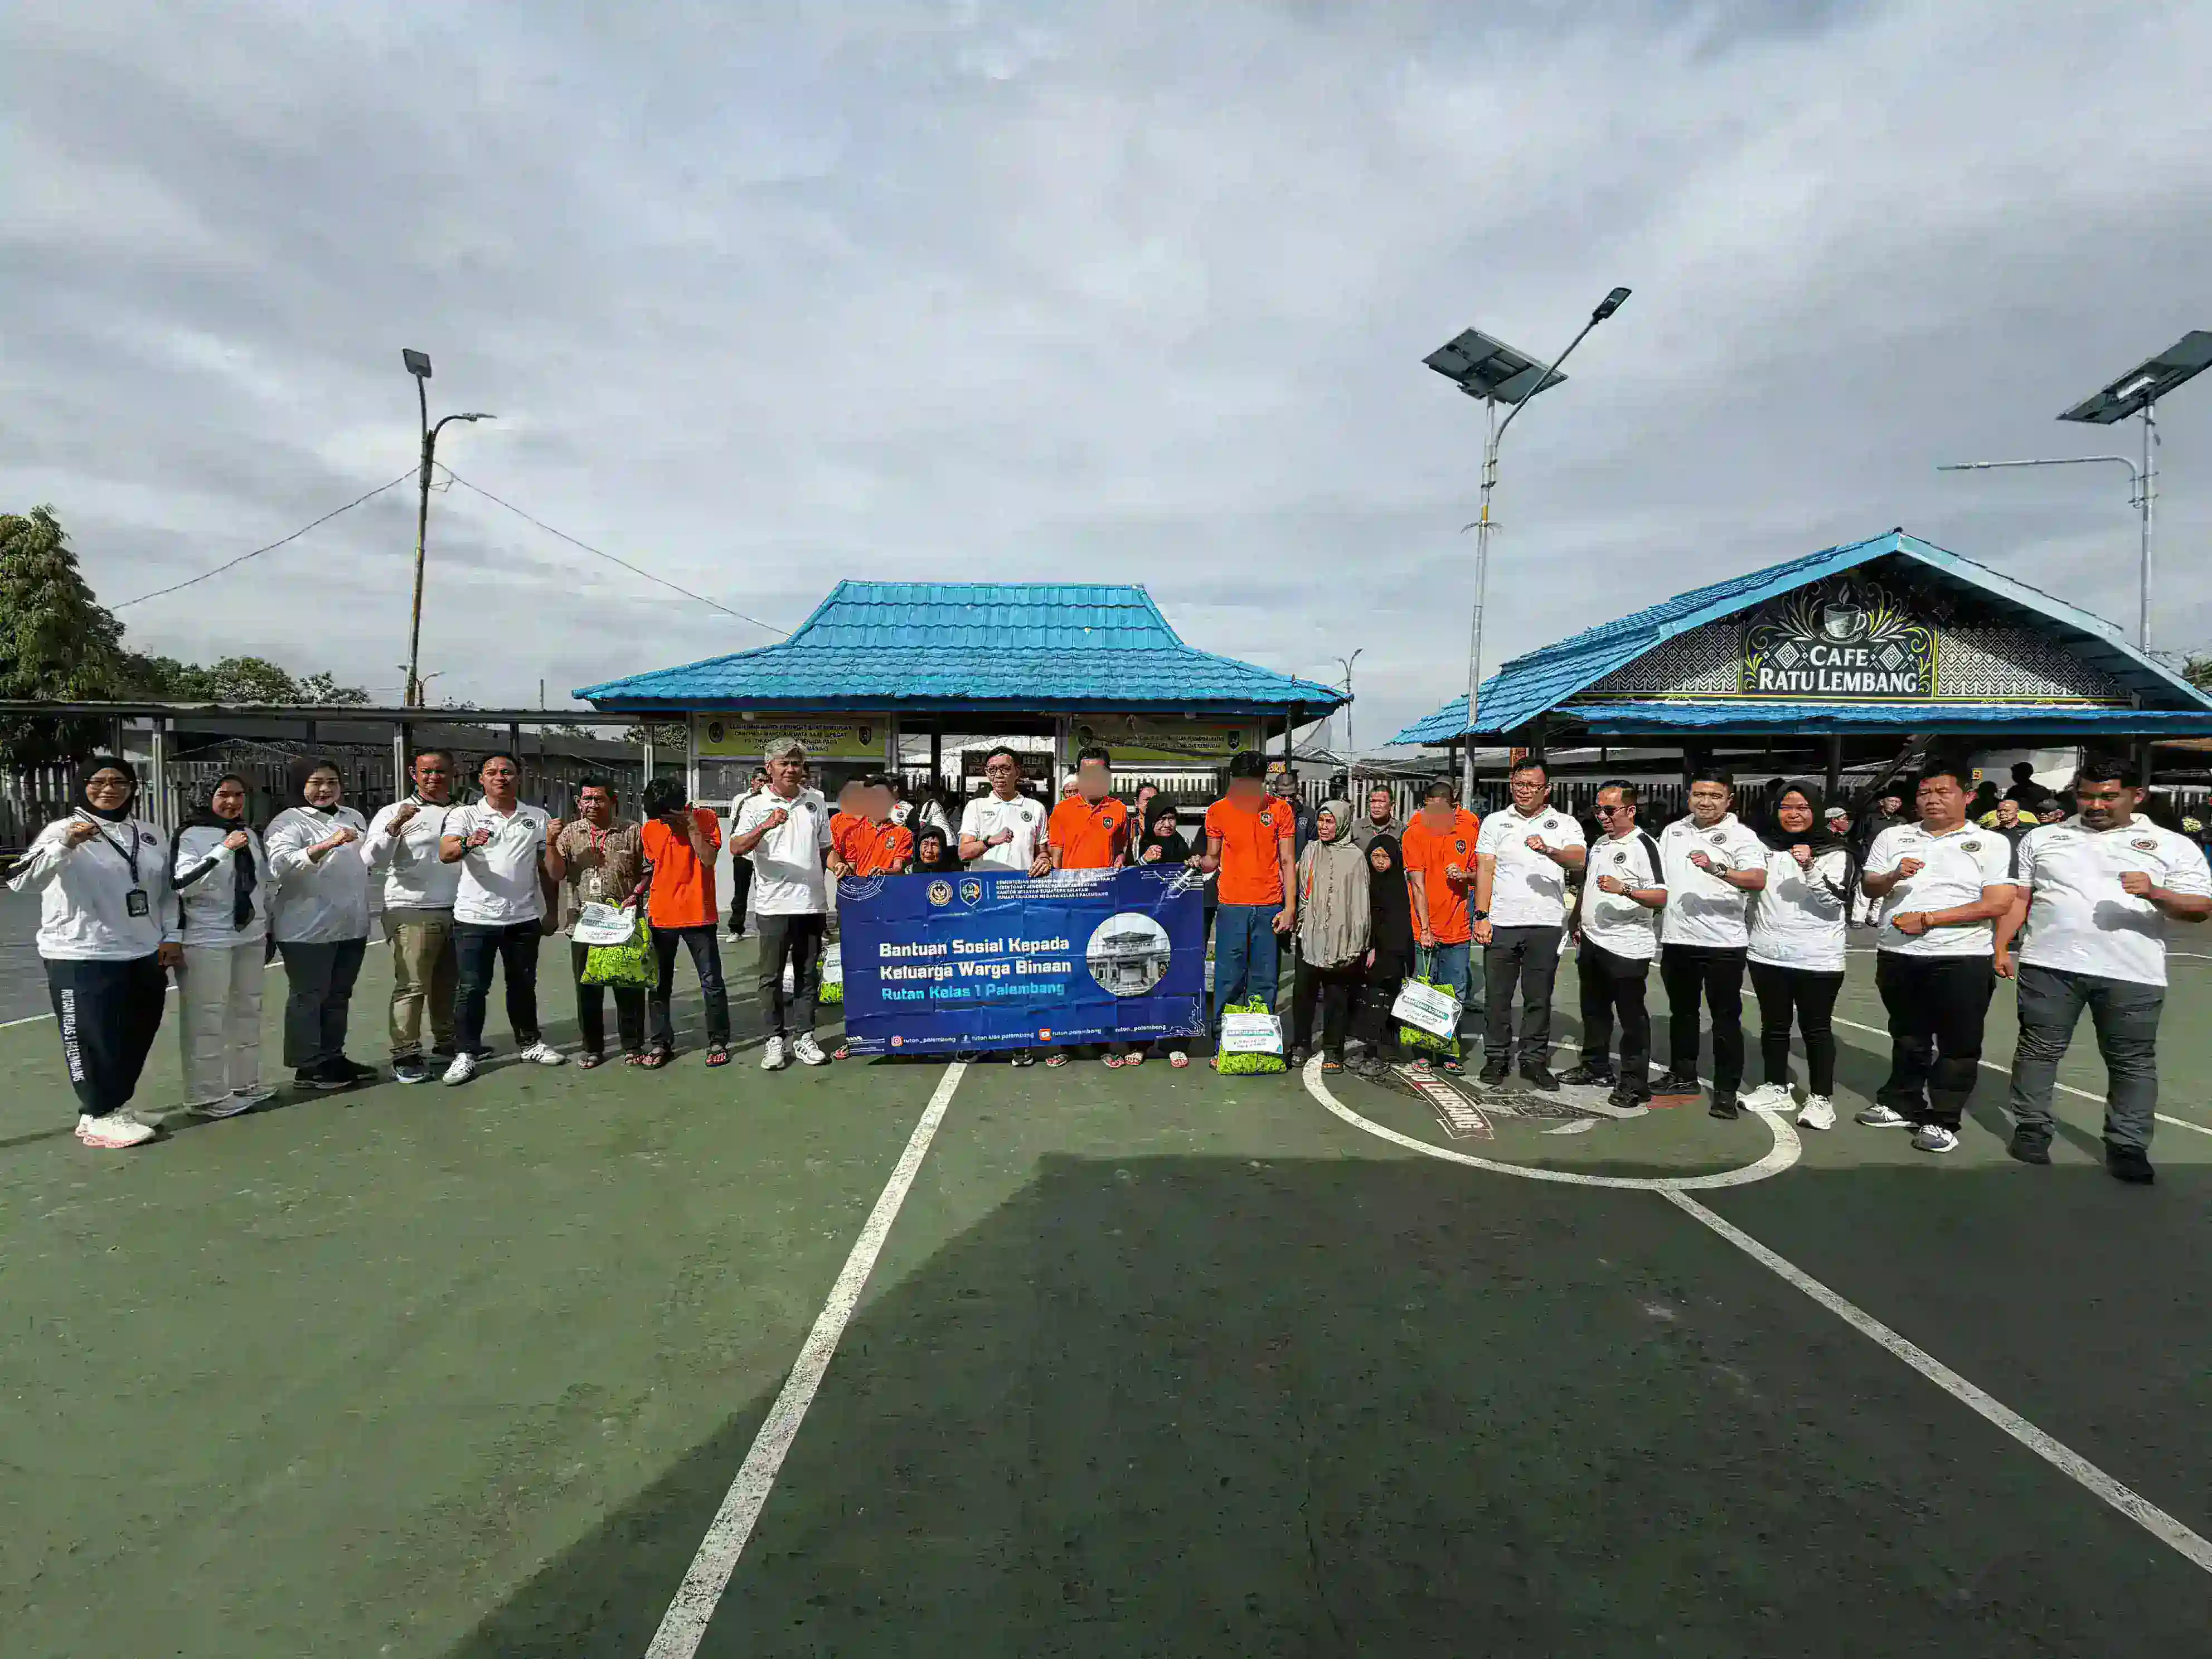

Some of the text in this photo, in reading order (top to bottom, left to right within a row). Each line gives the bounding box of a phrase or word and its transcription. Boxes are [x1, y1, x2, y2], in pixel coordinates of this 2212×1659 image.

[1810, 645, 1869, 666] CAFE
[1759, 668, 1917, 693] RATU LEMBANG
[880, 936, 1070, 957] Bantuan Sosial Kepada
[880, 959, 1071, 981] Keluarga Warga Binaan
[61, 989, 76, 1013] RUTAN
[882, 982, 1065, 1000] Rutan Kelas 1 Palembang
[62, 1013, 76, 1035] KELAS
[65, 1040, 85, 1081] PALEMBANG
